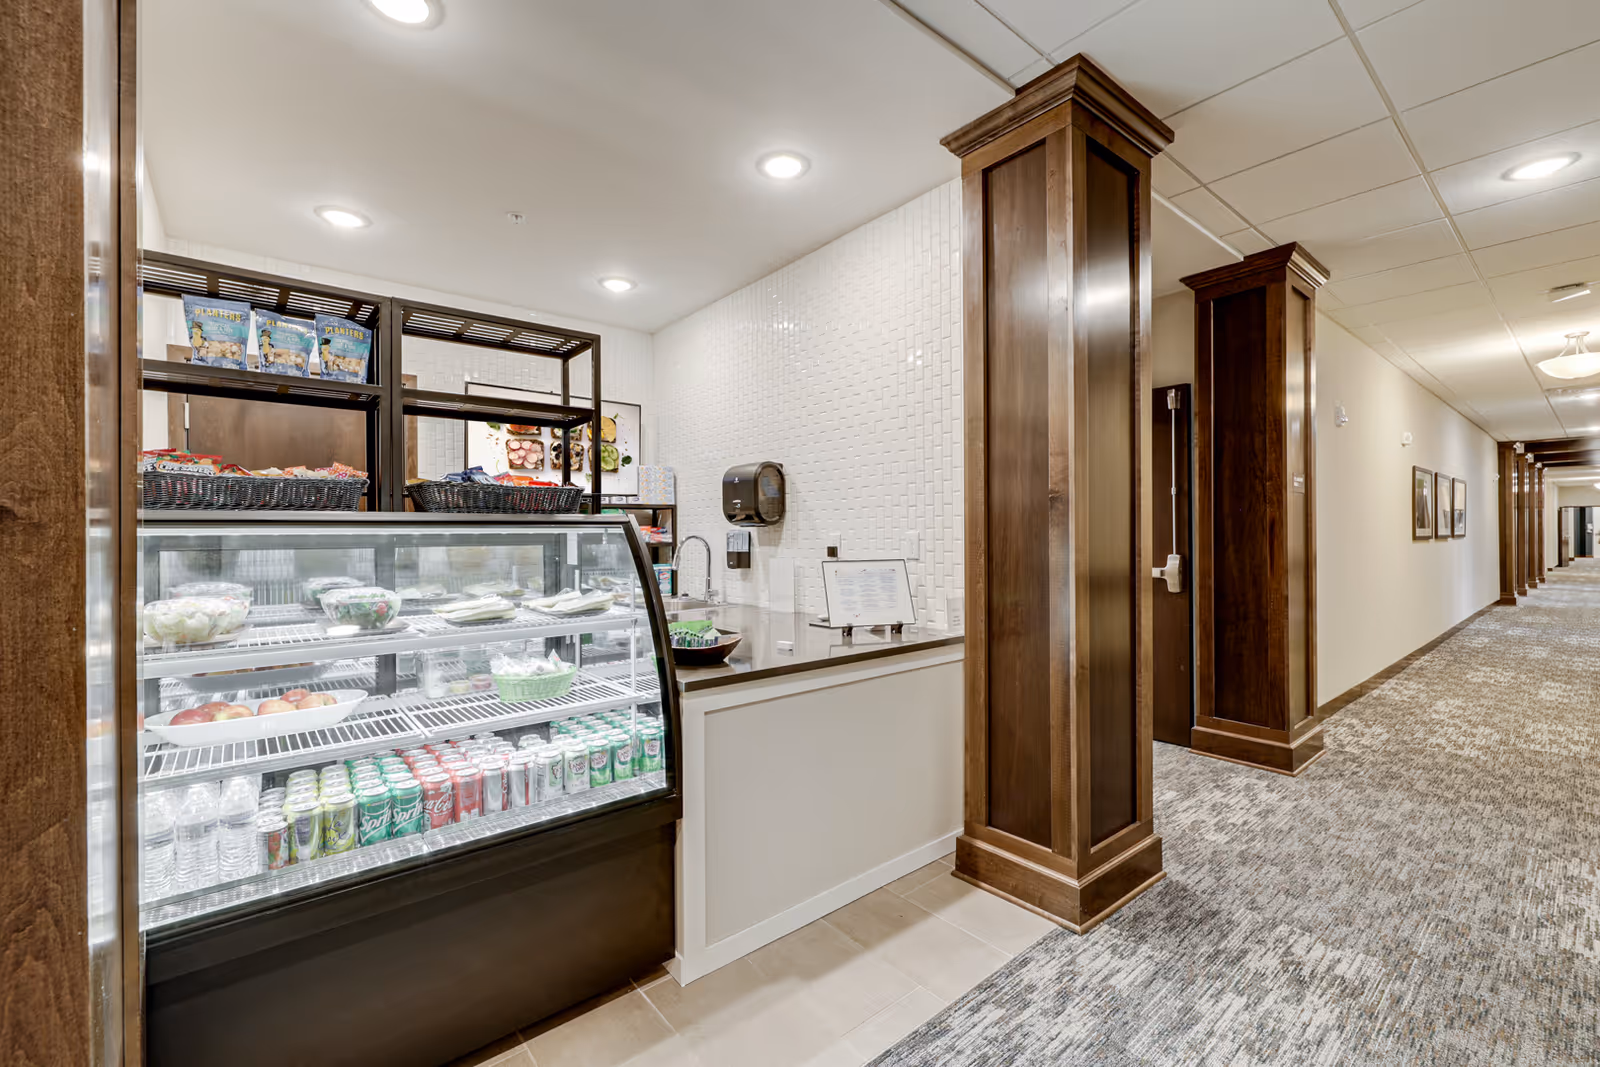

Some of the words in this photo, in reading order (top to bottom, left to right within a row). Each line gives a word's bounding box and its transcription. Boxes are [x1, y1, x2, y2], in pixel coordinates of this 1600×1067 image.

[194, 308, 242, 322] PLANTERS
[266, 320, 308, 334] PLANS
[325, 326, 364, 340] PLANTERS
[392, 801, 423, 824] Sprit
[360, 807, 392, 833] Sprit
